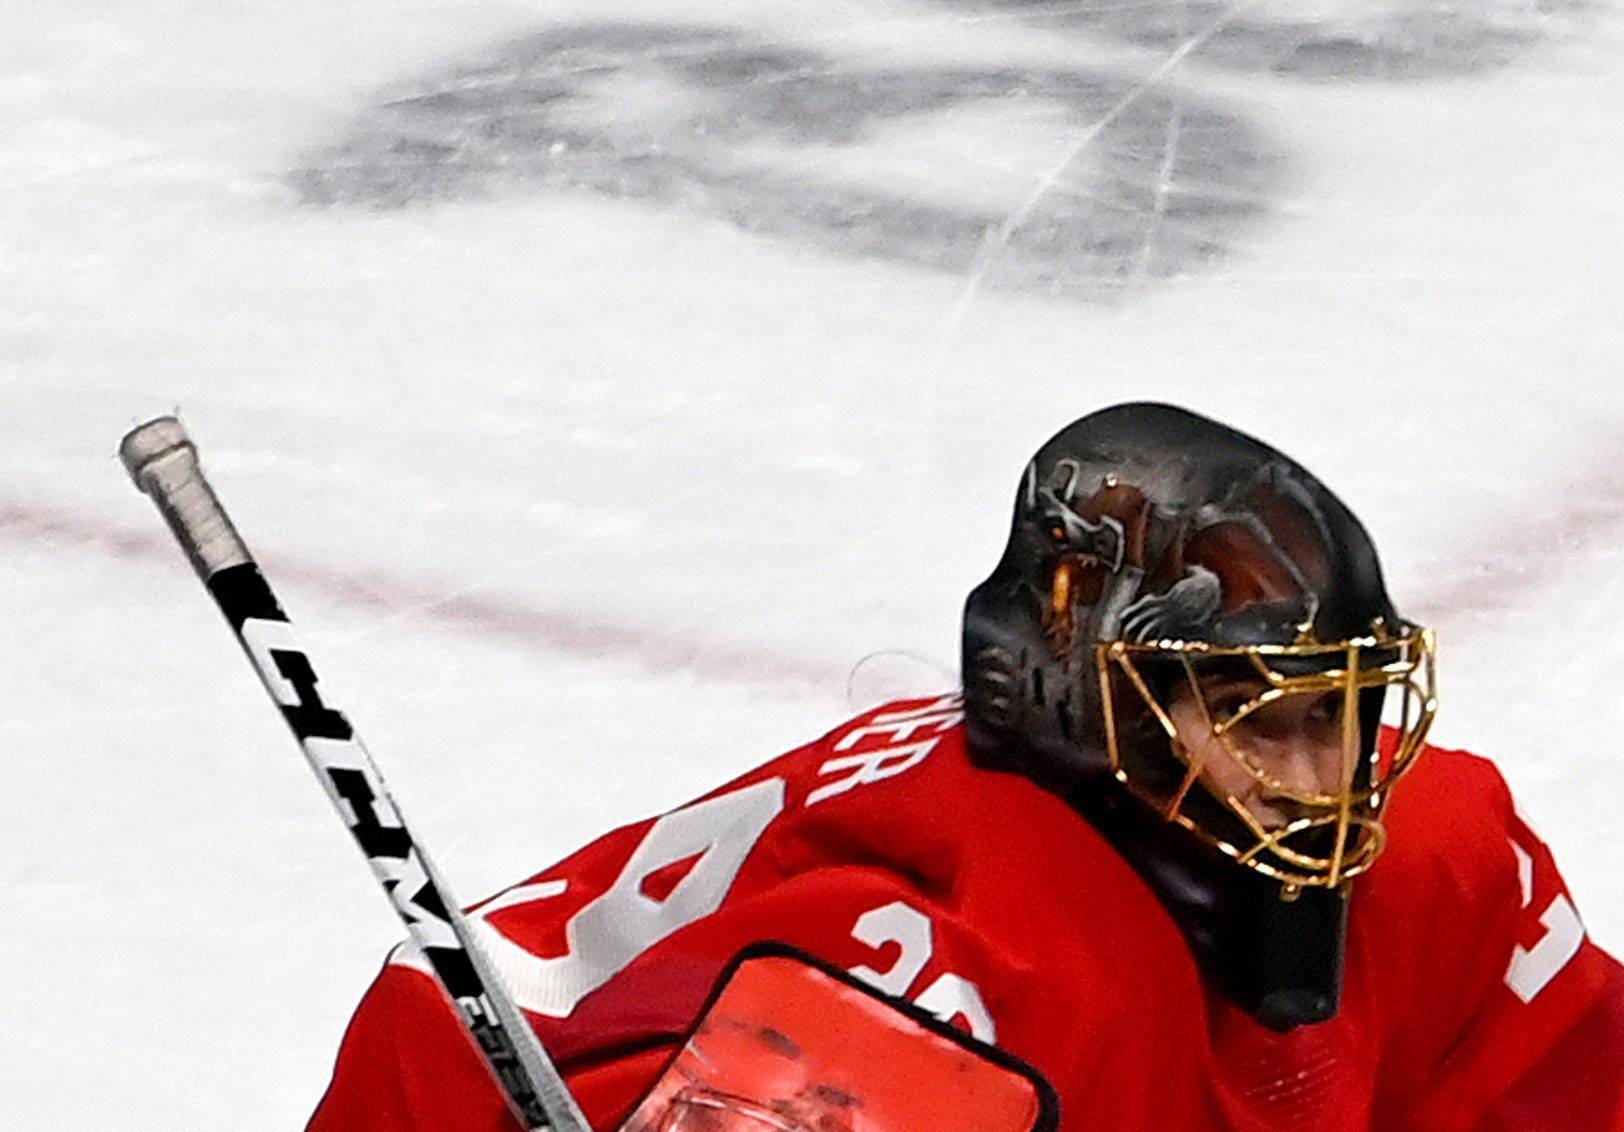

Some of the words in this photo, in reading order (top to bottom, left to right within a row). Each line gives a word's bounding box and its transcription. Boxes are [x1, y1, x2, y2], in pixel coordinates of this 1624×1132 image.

[240, 616, 466, 950] CCM
[804, 692, 966, 809] ER
[384, 775, 788, 1019] 9
